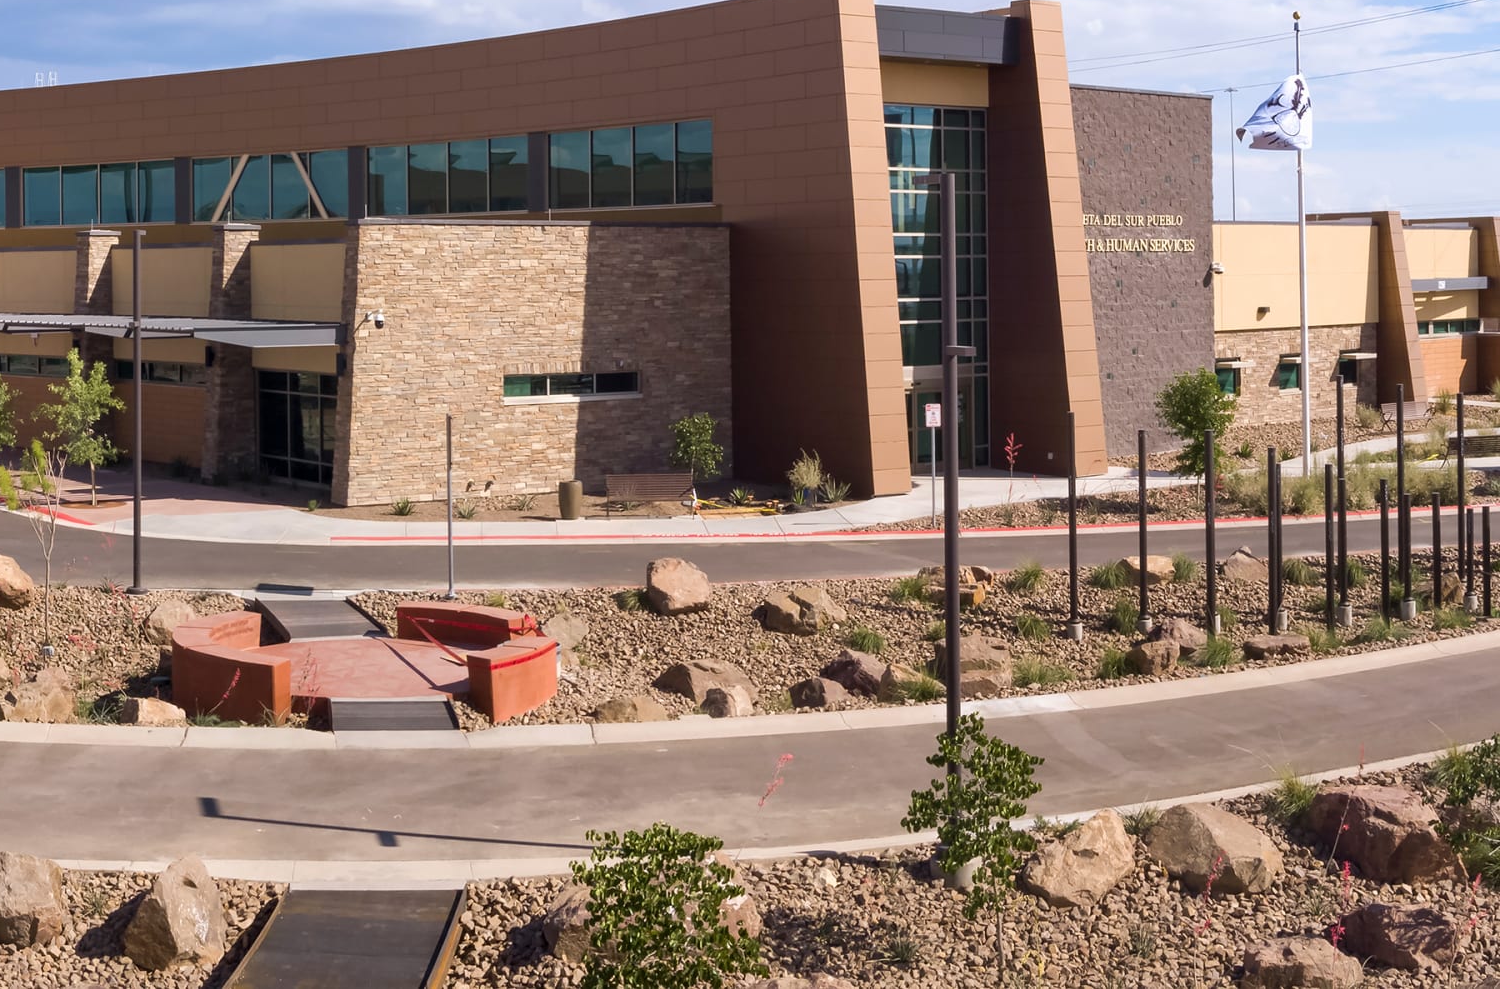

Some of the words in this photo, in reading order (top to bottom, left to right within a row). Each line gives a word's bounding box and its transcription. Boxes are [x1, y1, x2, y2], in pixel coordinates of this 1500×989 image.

[1083, 214, 1100, 225] ETA
[1103, 214, 1122, 226] DEL
[1125, 214, 1144, 226] SUR
[1146, 214, 1183, 226] PUEBLO
[1096, 238, 1104, 252] &
[1105, 238, 1148, 252] HUMAN
[1149, 238, 1195, 252] SERVICES
